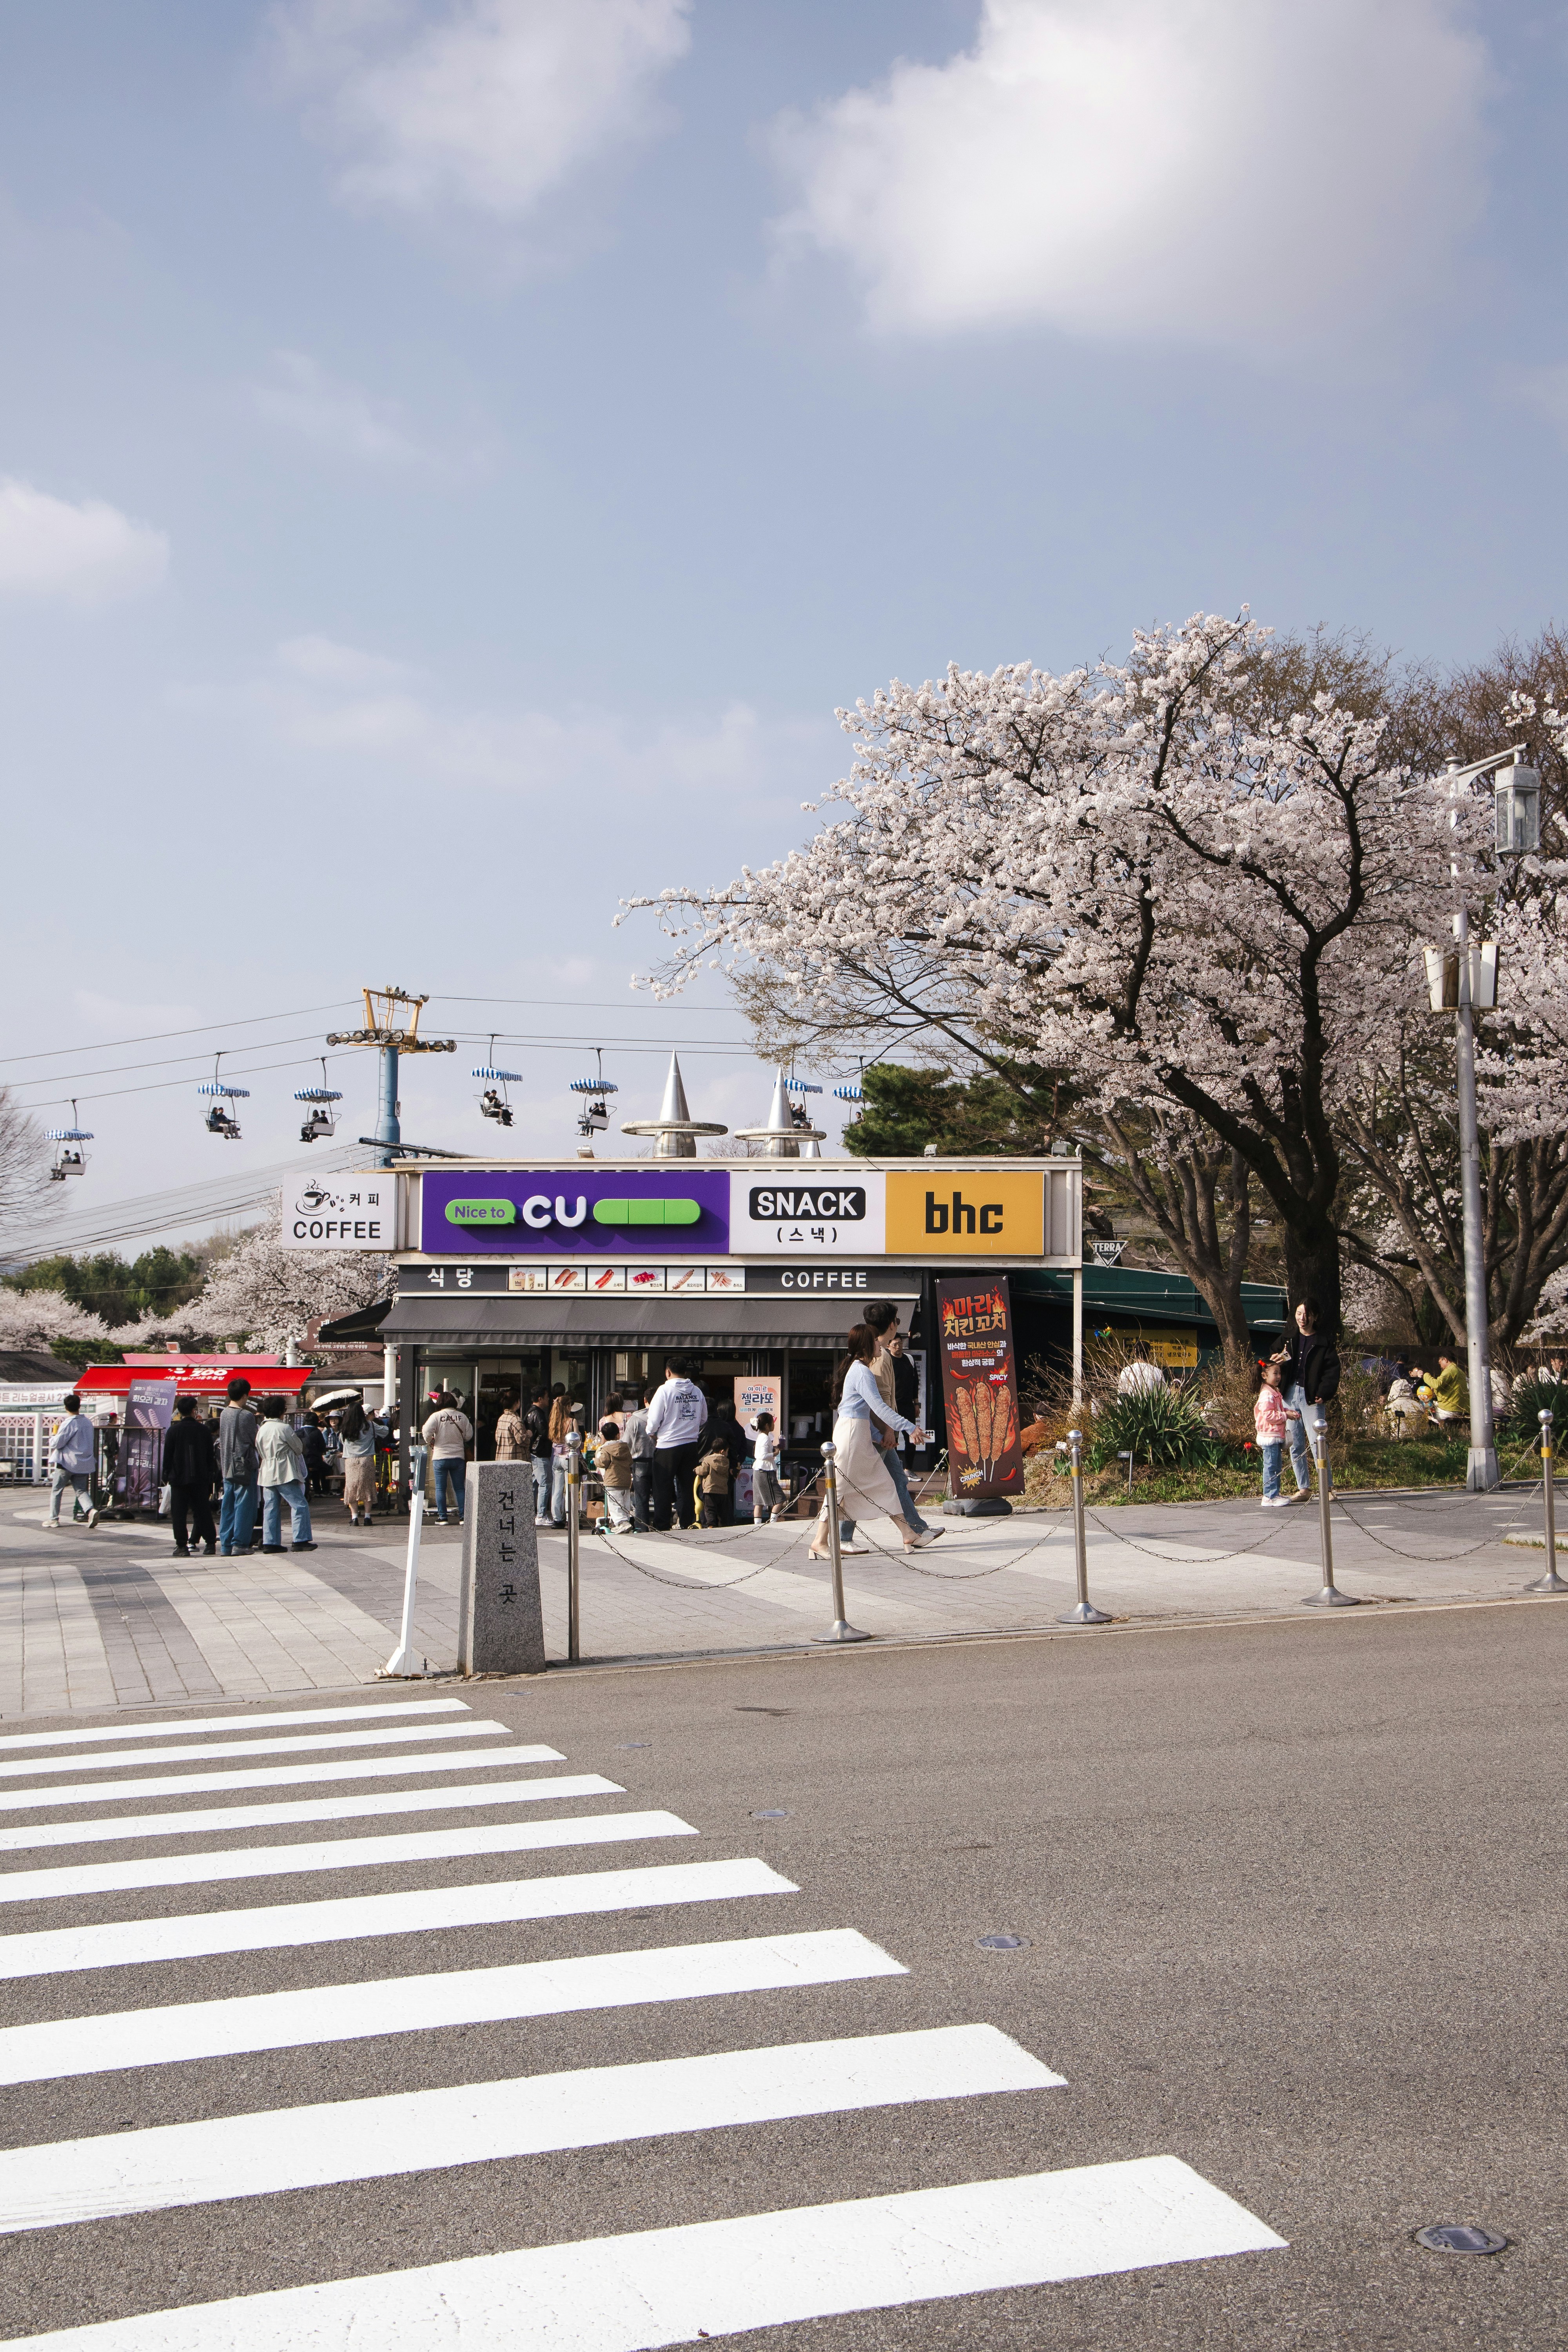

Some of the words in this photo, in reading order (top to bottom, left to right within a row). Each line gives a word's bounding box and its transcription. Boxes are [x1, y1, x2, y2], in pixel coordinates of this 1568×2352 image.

[350, 1193, 379, 1206] 커피
[757, 1192, 857, 1216] SNACK
[454, 1206, 486, 1218] Nice
[489, 1207, 505, 1218] to
[523, 1195, 587, 1229] CU
[925, 1191, 1004, 1234] bhc
[293, 1221, 381, 1239] COFFEE
[1092, 1243, 1122, 1253] TERRA
[781, 1272, 867, 1288] COFFEE
[953, 1294, 994, 1317] 마라
[951, 1350, 971, 1359] 매콤한
[972, 1349, 1003, 1357] 마라소스의
[961, 1359, 981, 1367] 환상적
[0, 1393, 10, 1402] 든
[12, 1393, 54, 1402] 리뉴얼공사
[132, 1395, 153, 1404] 회오리
[154, 1397, 168, 1406] 감자
[741, 1393, 773, 1405] 젤라또
[960, 1470, 984, 1483] CRUNCH
[498, 1491, 517, 1562] 건너는
[499, 1584, 517, 1605] 곳
